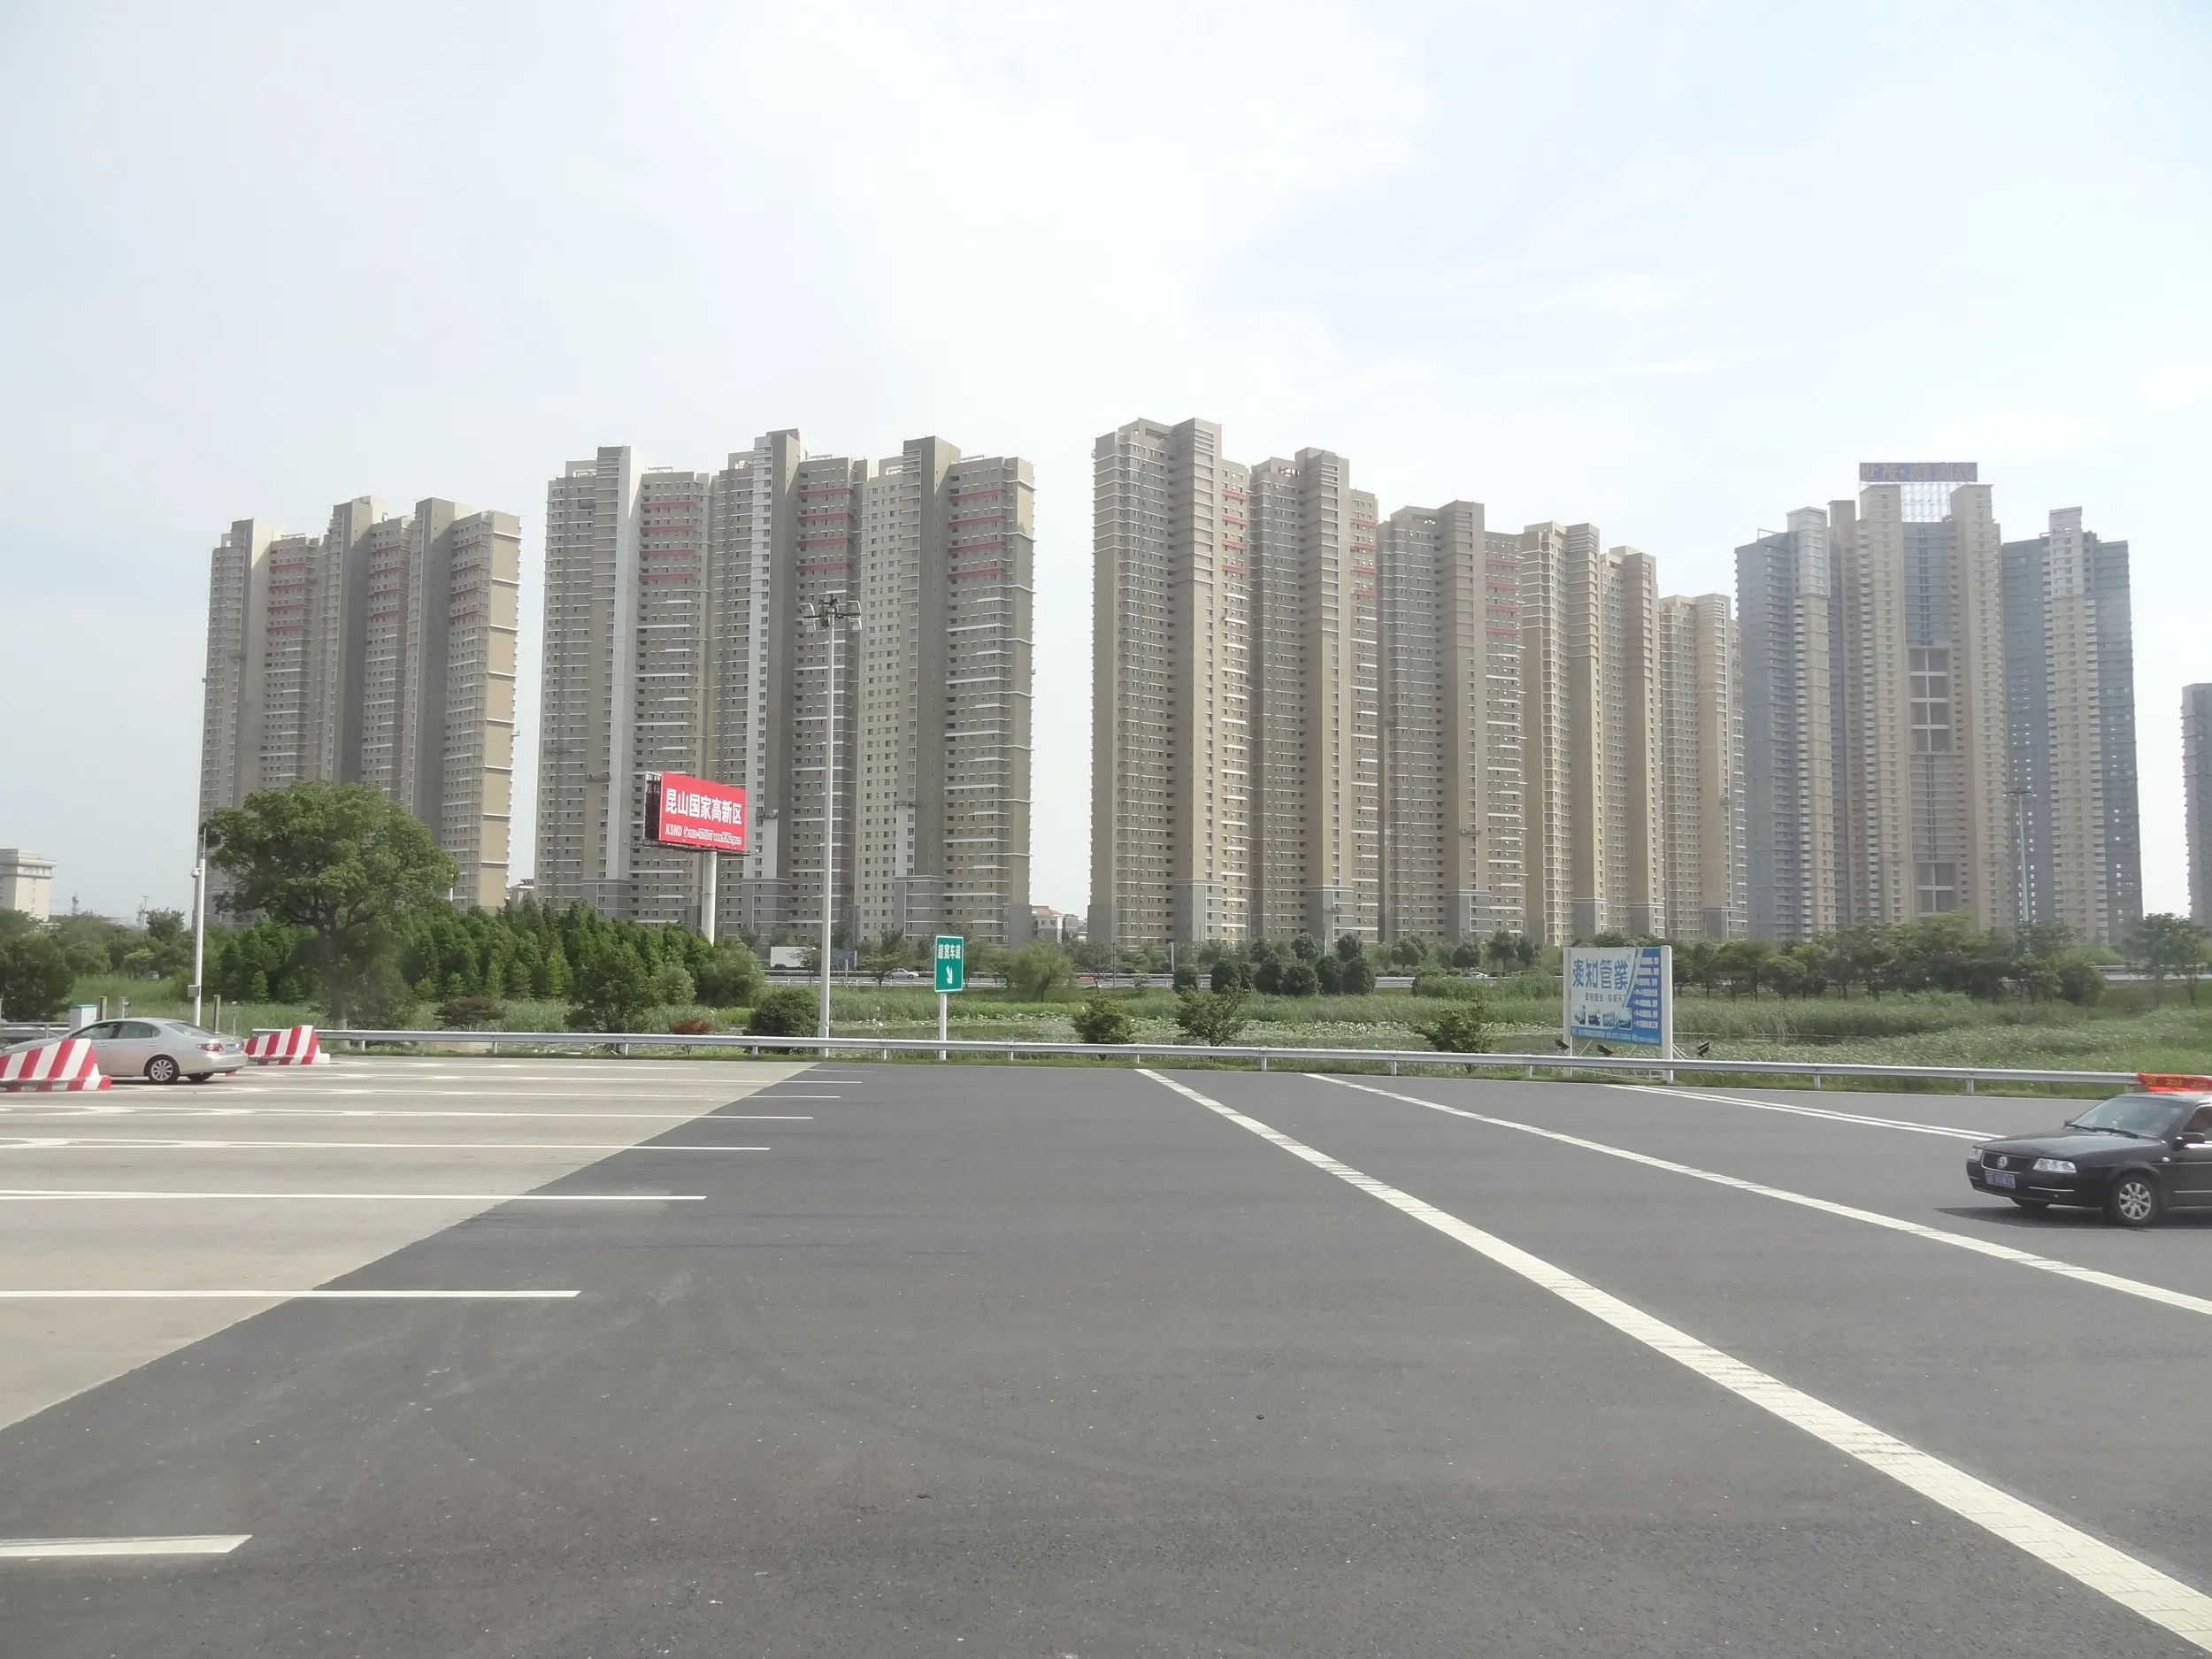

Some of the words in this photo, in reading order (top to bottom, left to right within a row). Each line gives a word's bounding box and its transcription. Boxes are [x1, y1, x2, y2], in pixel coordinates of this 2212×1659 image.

[665, 787, 742, 825] 昆山国家高新区
[665, 823, 683, 837] KSND
[938, 943, 961, 959] 超宽车道
